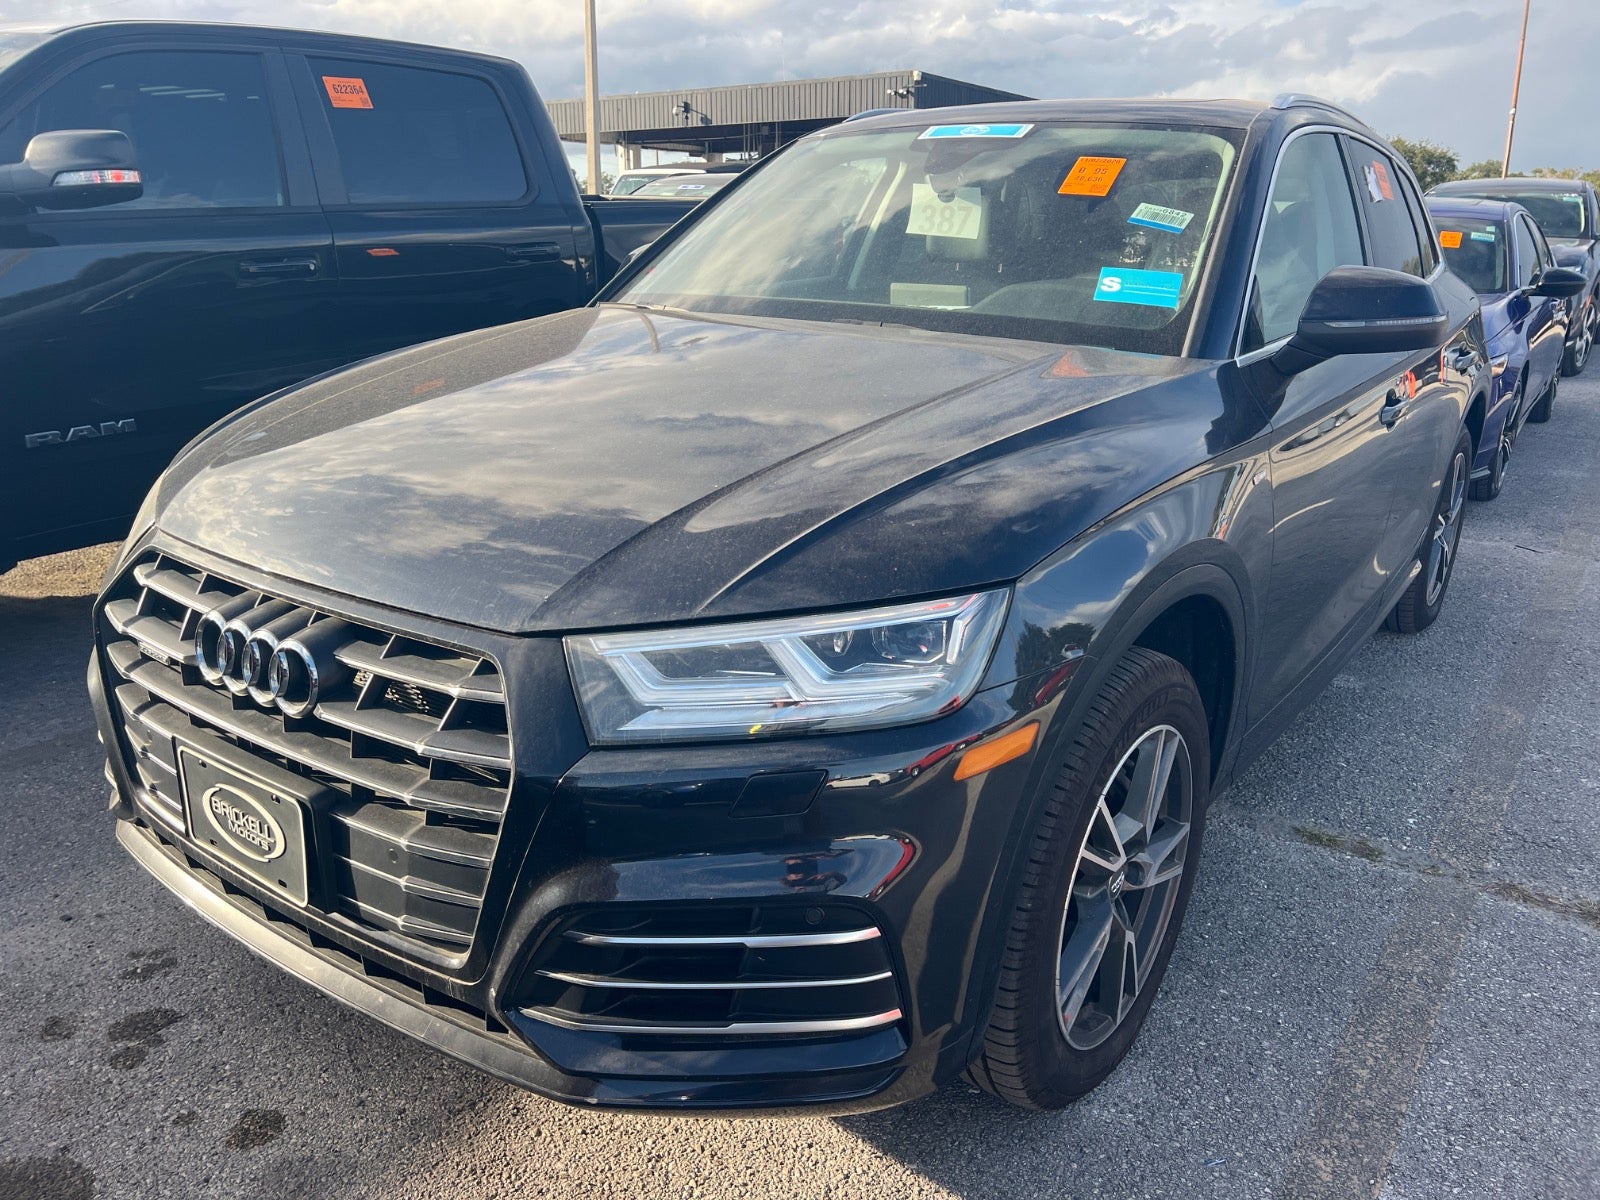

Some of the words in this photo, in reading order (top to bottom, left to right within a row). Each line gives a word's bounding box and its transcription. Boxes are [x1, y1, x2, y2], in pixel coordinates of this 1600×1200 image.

[918, 204, 974, 235] 387
[1100, 276, 1122, 292] S
[25, 418, 137, 448] RAM
[211, 796, 276, 843] BRICKELL
